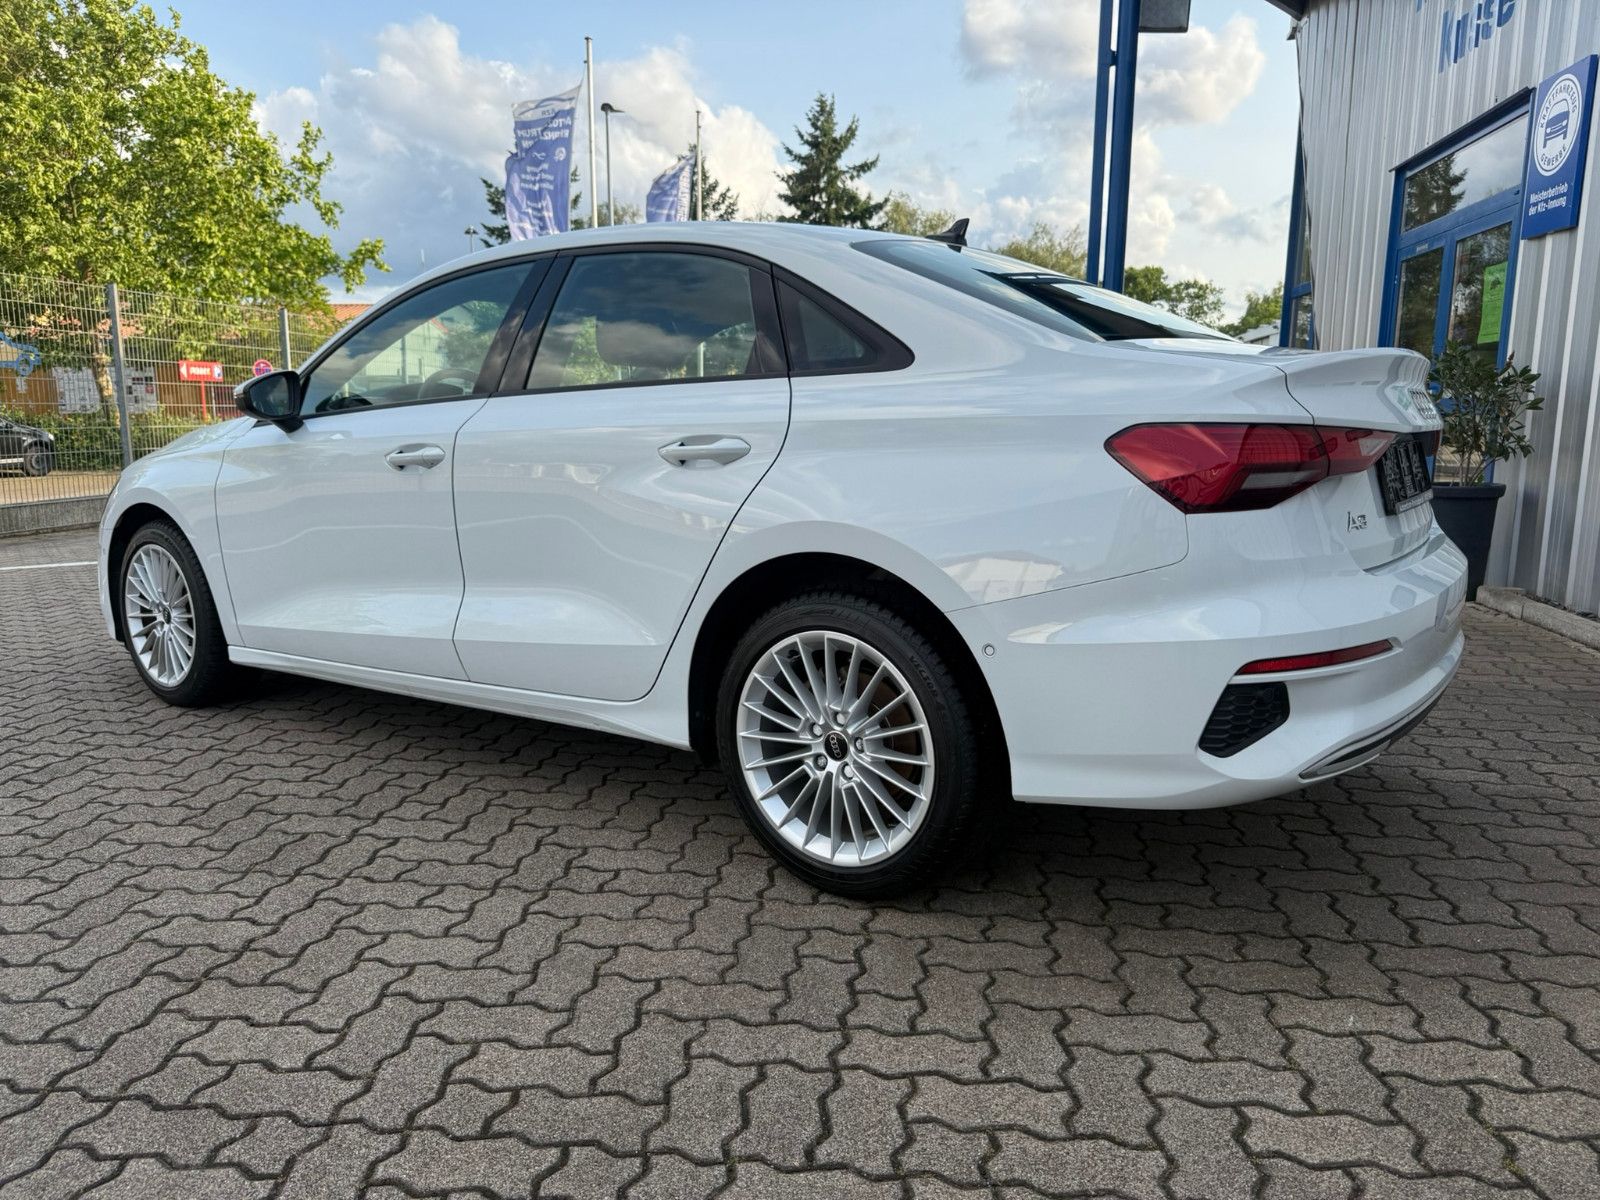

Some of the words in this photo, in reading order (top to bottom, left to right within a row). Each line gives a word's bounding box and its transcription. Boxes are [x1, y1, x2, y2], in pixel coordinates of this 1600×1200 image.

[1540, 82, 1578, 129] KRAFTFAHRZEUG
[1540, 144, 1567, 167] GEWERBE
[1530, 182, 1568, 204] Meisterbetrieb
[1529, 205, 1537, 216] der
[1347, 511, 1367, 532] A3
